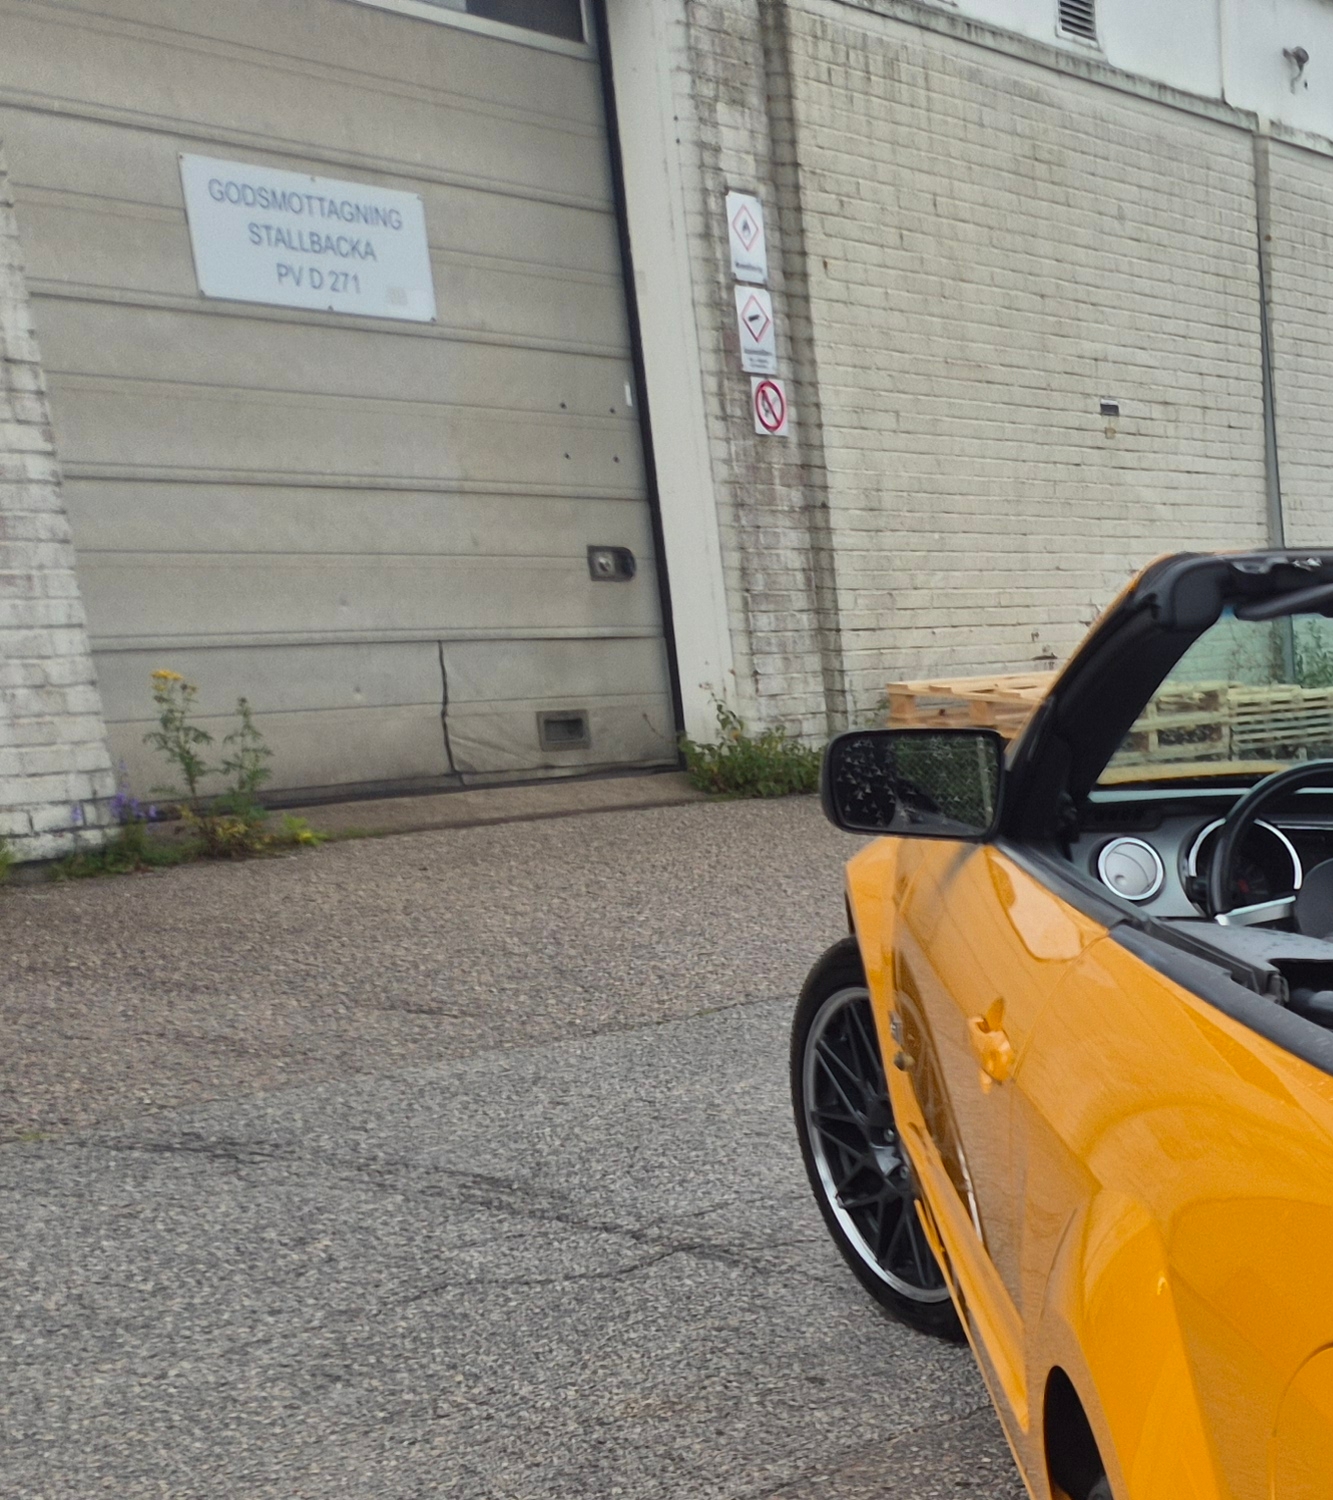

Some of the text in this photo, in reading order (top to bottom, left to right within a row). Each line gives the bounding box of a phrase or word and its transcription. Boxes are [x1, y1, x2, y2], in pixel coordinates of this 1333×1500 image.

[208, 178, 403, 231] GODSMOTTAGNING
[248, 222, 378, 263] STALLBACKA
[276, 263, 361, 294] PV D 271
